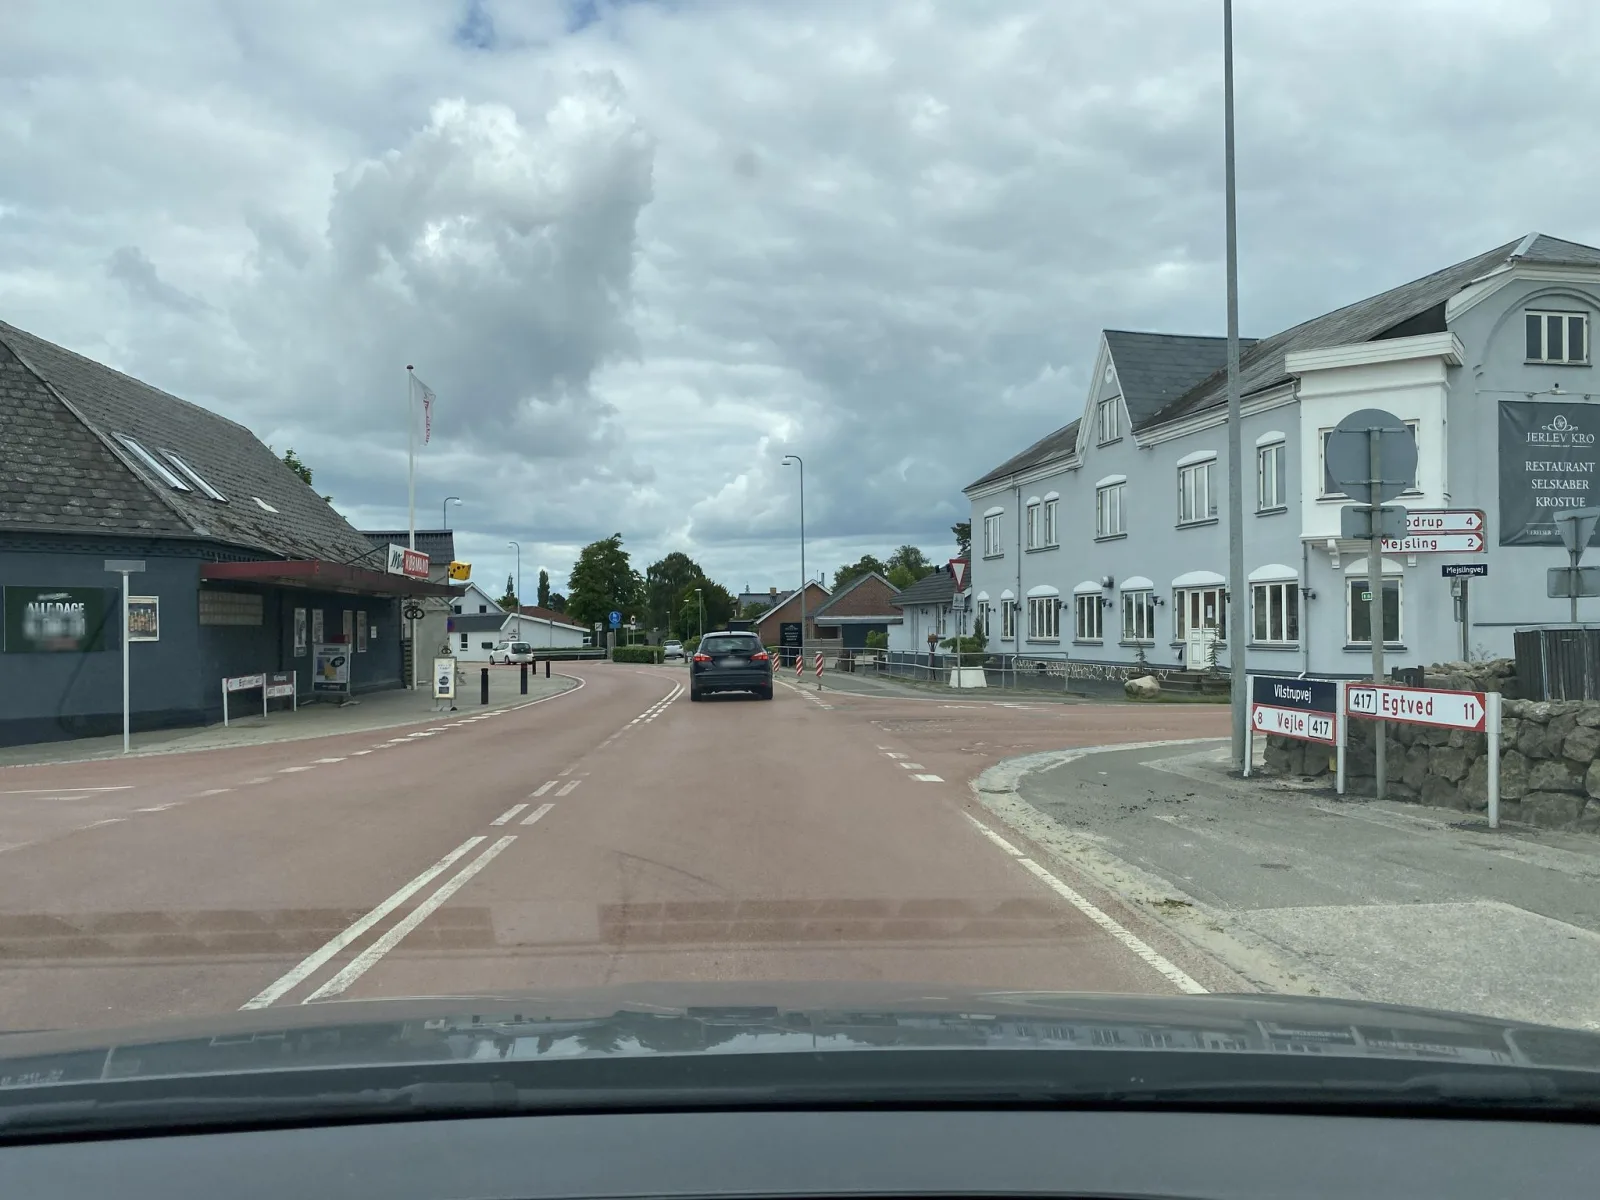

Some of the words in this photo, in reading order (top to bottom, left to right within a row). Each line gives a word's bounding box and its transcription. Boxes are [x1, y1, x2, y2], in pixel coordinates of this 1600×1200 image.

[1526, 432, 1568, 443] JERLEV
[1571, 433, 1595, 443] KRO
[1525, 461, 1596, 472] RESTAURANT
[1531, 479, 1590, 490] SELSKABER
[1535, 497, 1586, 507] KROSTUE
[1406, 516, 1443, 528] odrup
[1466, 517, 1473, 526] 4
[1381, 538, 1437, 550] Mejsling
[1467, 538, 1474, 547] 2
[1446, 566, 1484, 575] Mejslingvej
[1274, 684, 1312, 703] Vilstrupvej
[1353, 693, 1372, 709] 417
[1382, 692, 1433, 716] Egtved
[1463, 703, 1475, 720] 11
[1257, 711, 1263, 725] 8
[1277, 713, 1304, 733] Vejle
[1312, 720, 1329, 735] 417
